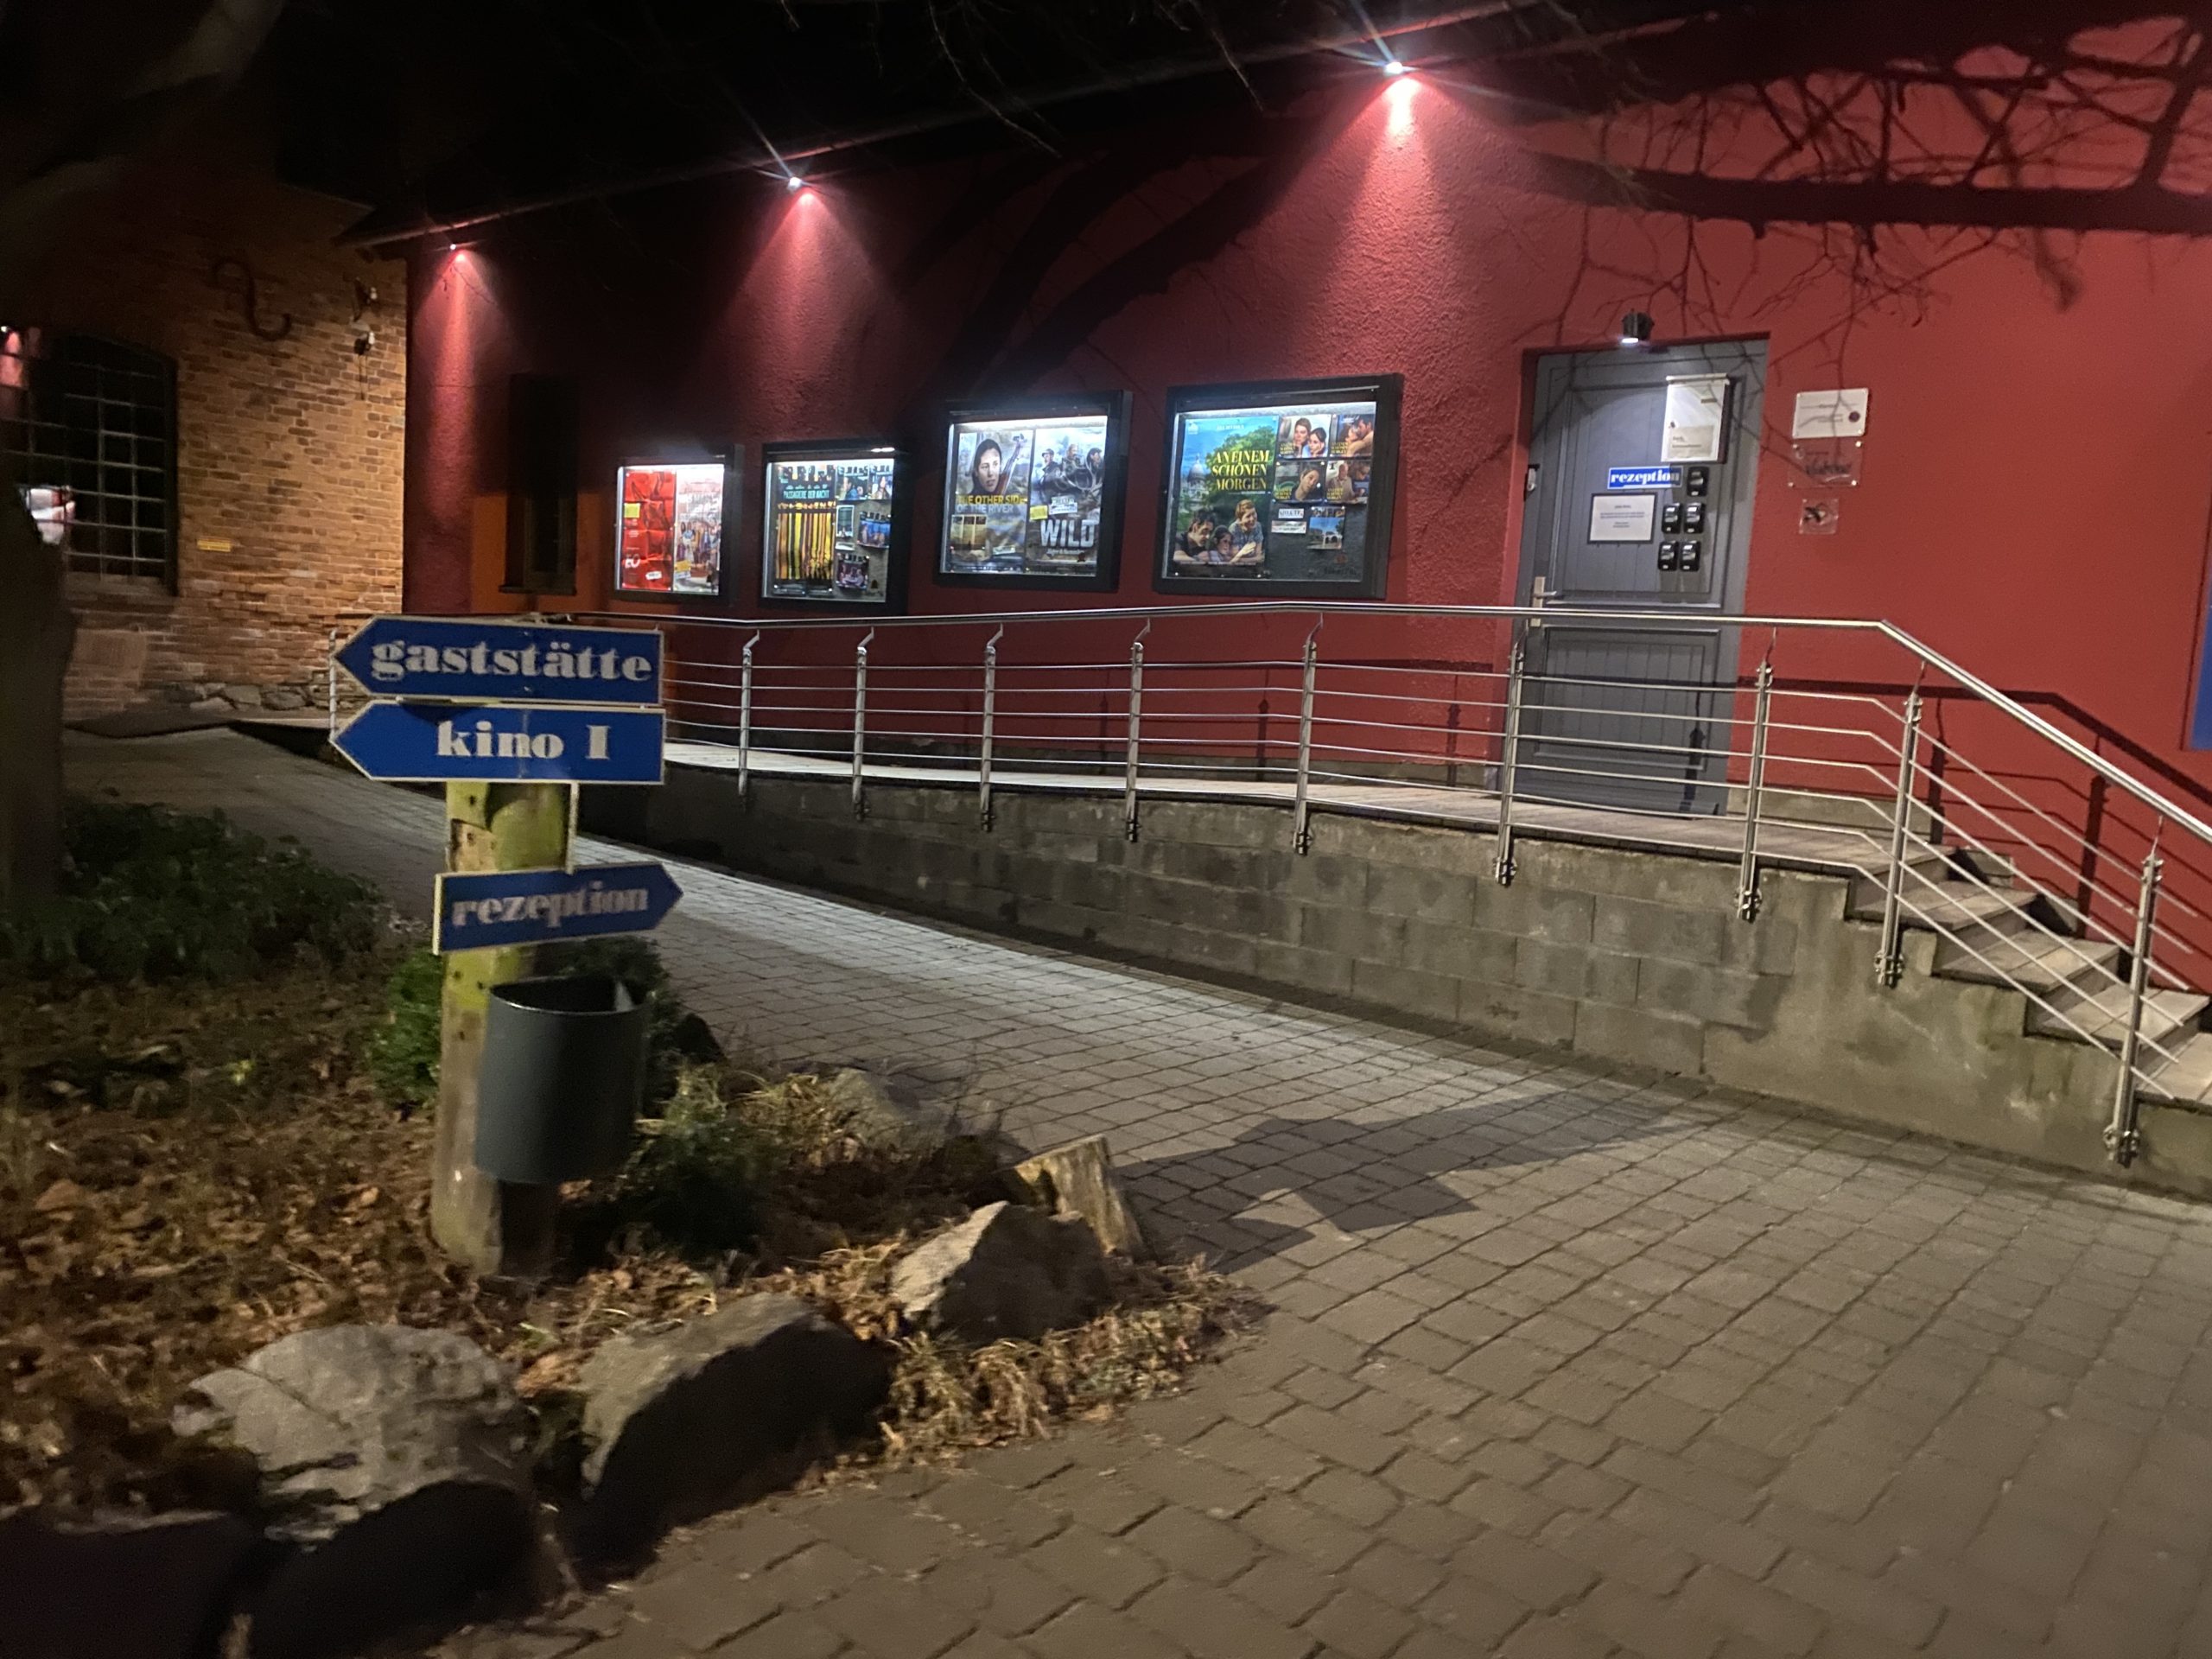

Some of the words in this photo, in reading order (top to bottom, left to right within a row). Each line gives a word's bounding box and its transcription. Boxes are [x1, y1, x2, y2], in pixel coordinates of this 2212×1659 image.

[1213, 451, 1230, 464] AN
[1231, 449, 1270, 463] EINEM
[1211, 461, 1268, 476] SCHÖNEN
[1216, 477, 1268, 490] MORGEN
[1610, 469, 1680, 486] rezeption
[975, 494, 1004, 505] OTHER
[956, 504, 967, 513] OF
[969, 504, 987, 513] THE
[988, 504, 1014, 513] RIVER
[1040, 519, 1099, 548] WILD
[371, 639, 652, 682] gaststätte
[435, 720, 564, 760] kino
[452, 880, 649, 929] rezeption
